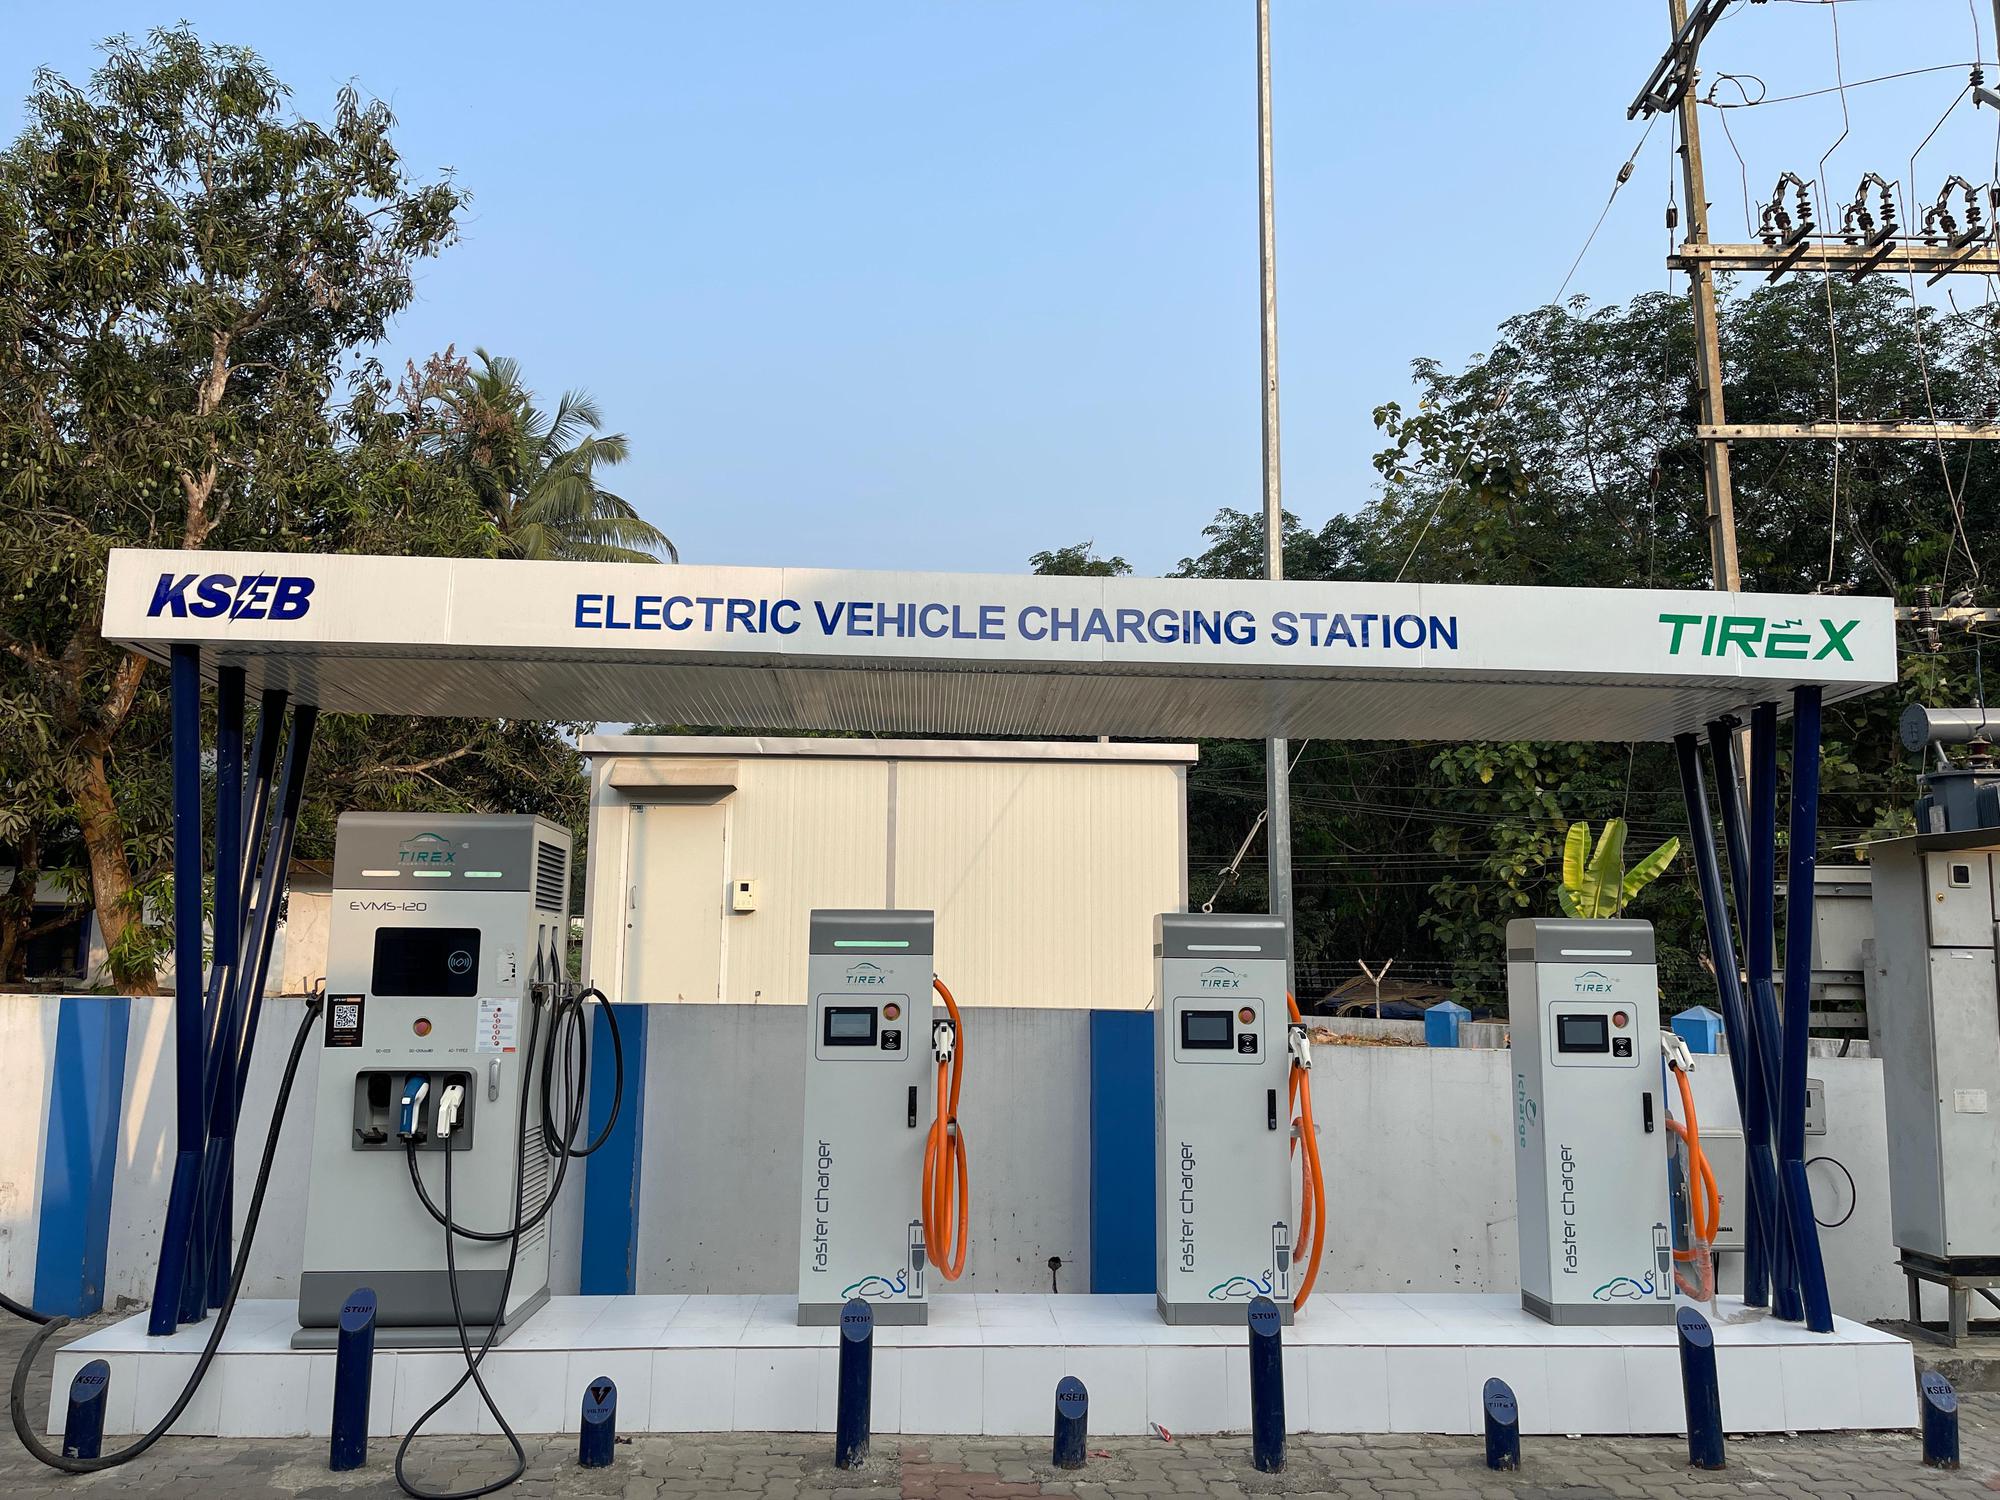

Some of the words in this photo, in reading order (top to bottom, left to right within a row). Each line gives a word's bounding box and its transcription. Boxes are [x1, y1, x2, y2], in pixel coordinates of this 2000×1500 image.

[146, 571, 316, 623] KSEB
[574, 593, 801, 635] ELECTRIC
[814, 600, 1006, 641] VEHICLE
[1017, 605, 1257, 645] CHARGING
[1270, 611, 1459, 650] STATION
[1658, 613, 1861, 662] TIREX
[399, 851, 457, 862] TIREX
[349, 901, 428, 912] EVMS-120
[846, 975, 886, 984] TIREX
[1200, 979, 1240, 988] TIREX
[1575, 984, 1612, 992] TIREX
[814, 1140, 832, 1213] charger
[1179, 1142, 1196, 1214] charger
[1560, 1143, 1576, 1216] charger
[812, 1217, 828, 1273] faster
[1180, 1218, 1195, 1273] faster
[1562, 1220, 1578, 1274] faster
[344, 1305, 372, 1313] STOP
[844, 1315, 870, 1323] STOP
[1251, 1312, 1277, 1320] STOP
[1682, 1323, 1708, 1331] STOP
[75, 1375, 106, 1385] KSEB
[1926, 1386, 1952, 1395] KSEB
[1059, 1392, 1086, 1402] KSEB
